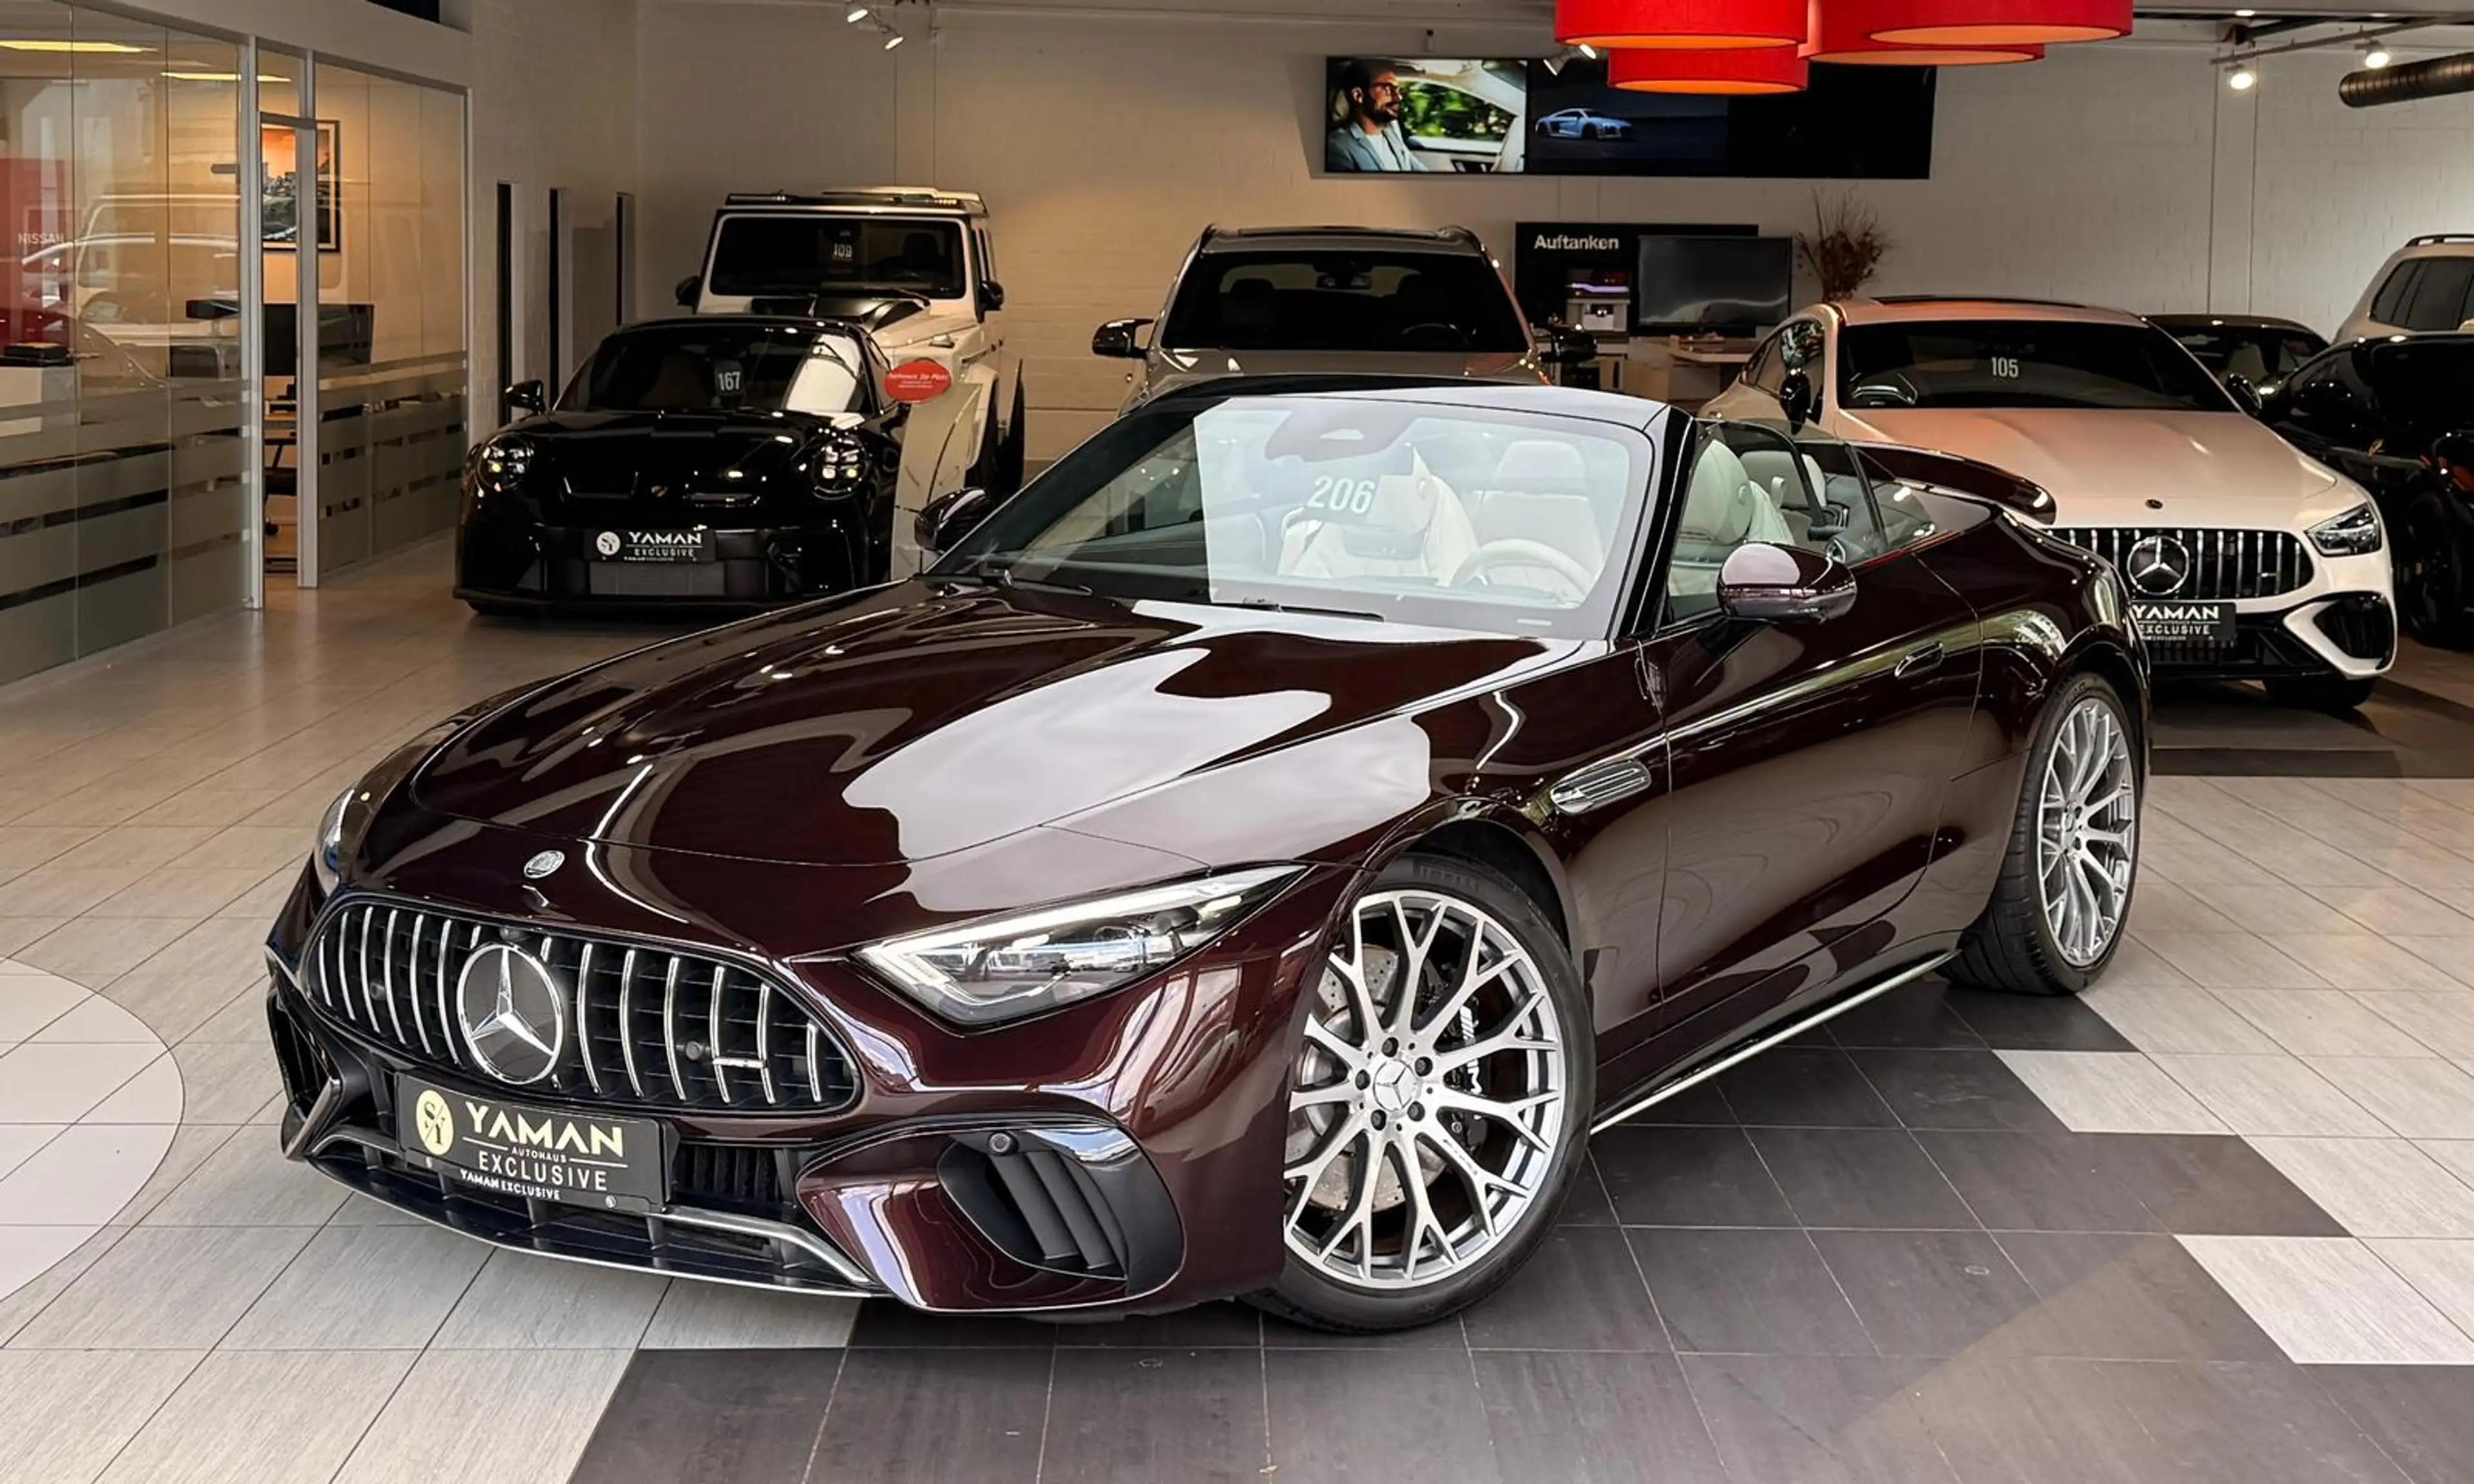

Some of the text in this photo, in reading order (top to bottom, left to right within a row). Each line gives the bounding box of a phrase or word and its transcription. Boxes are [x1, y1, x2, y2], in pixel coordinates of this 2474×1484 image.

[1533, 234, 1620, 251] Auftanken
[1991, 356, 2019, 378] 105
[717, 370, 740, 391] 167
[1307, 475, 1376, 515] 206
[628, 531, 702, 545] YAMAN
[633, 547, 695, 557] EXCLUSIVE
[2132, 604, 2219, 620] YAMAN
[465, 1101, 624, 1158] YAMAN
[511, 1146, 567, 1164] AUTOHAUS
[478, 1150, 608, 1192] EXCLUSIVE
[459, 1168, 561, 1201] YAMAN EXCLUSIVE
